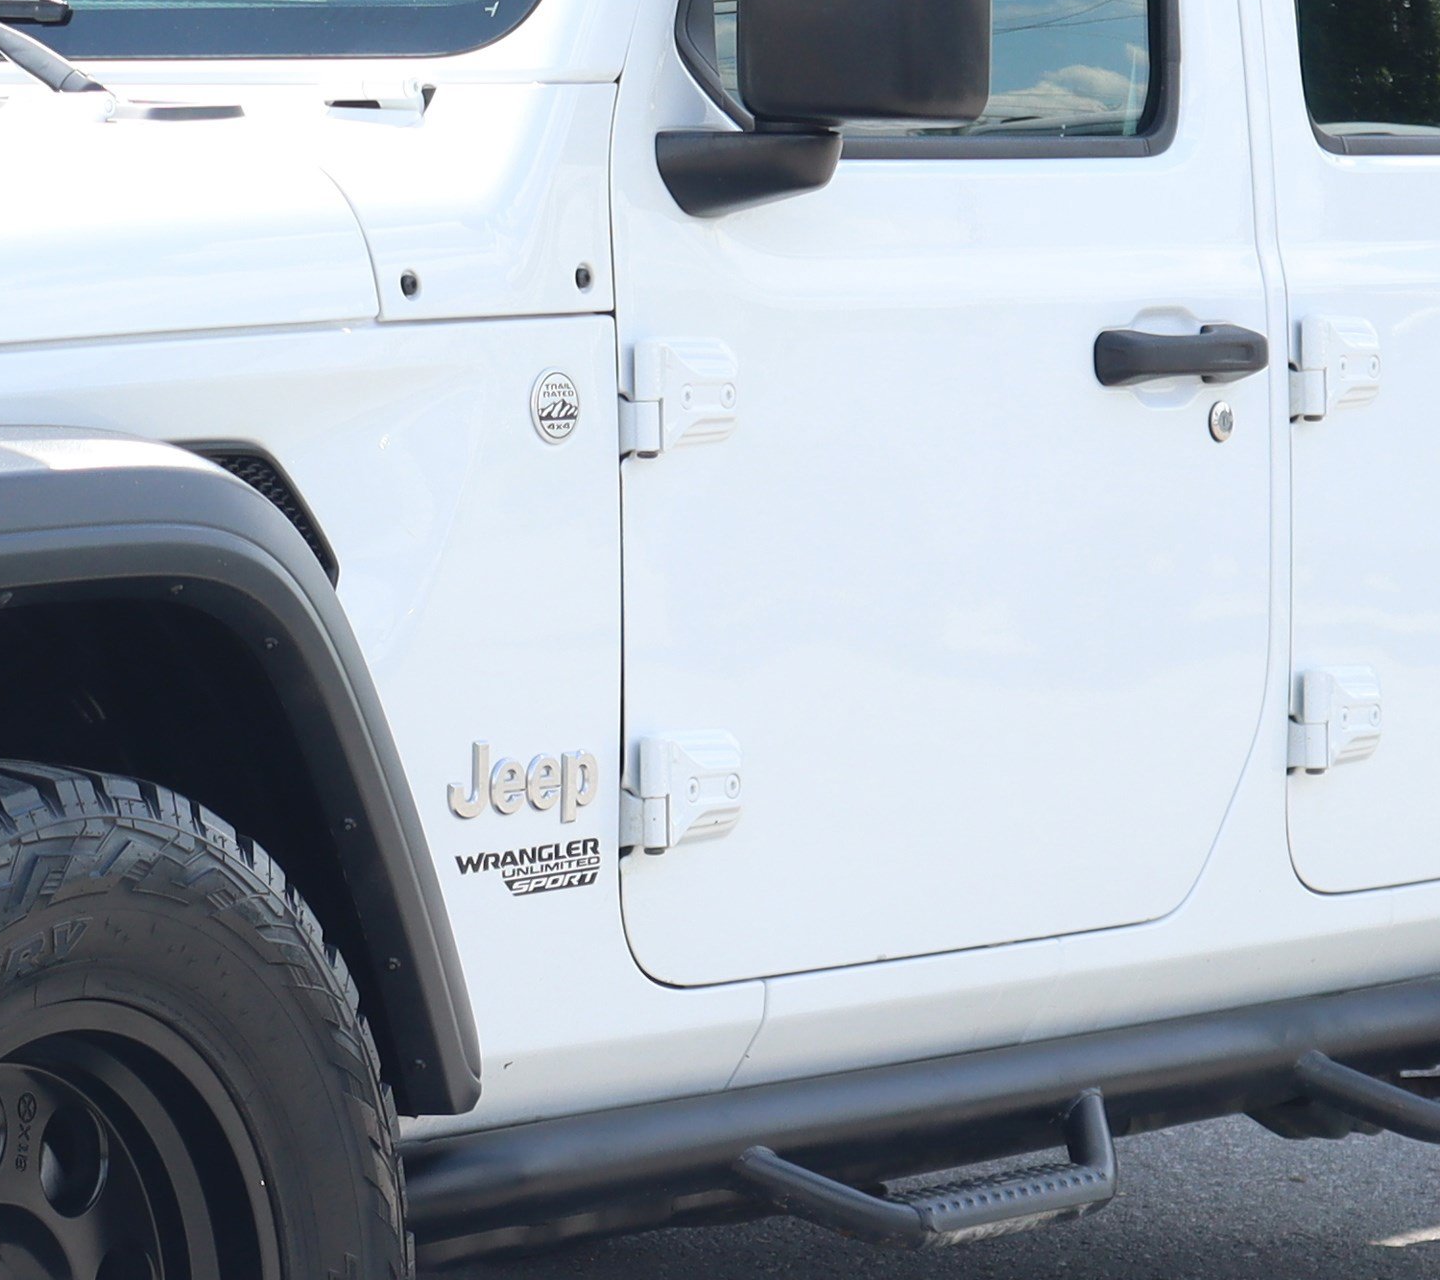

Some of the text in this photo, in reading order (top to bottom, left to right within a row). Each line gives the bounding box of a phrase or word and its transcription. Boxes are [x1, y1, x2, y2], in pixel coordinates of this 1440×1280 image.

[542, 390, 575, 399] RATED
[446, 739, 599, 824] Jeep
[455, 837, 601, 876] WRANGLER
[502, 855, 601, 879] UNLIMITED
[508, 870, 600, 894] SPORT
